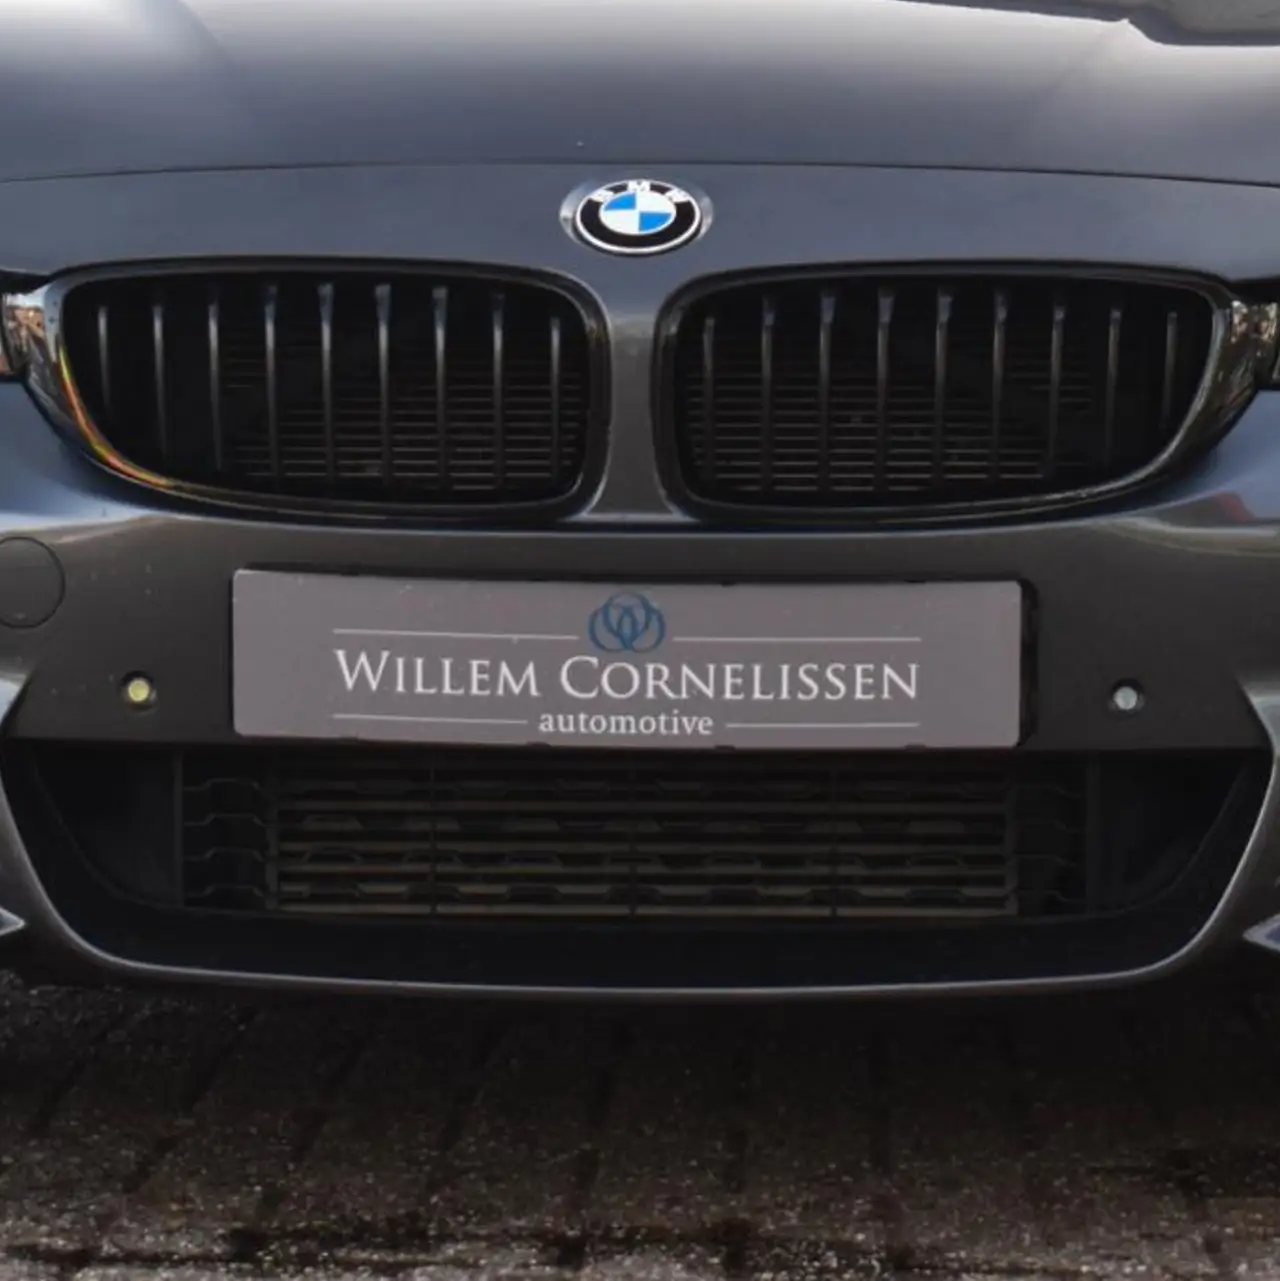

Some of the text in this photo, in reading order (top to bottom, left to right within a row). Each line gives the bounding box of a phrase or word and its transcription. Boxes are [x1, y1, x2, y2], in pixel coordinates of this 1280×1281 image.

[333, 648, 920, 701] WILLEM CORNELISSEN
[538, 709, 714, 736] automotive
